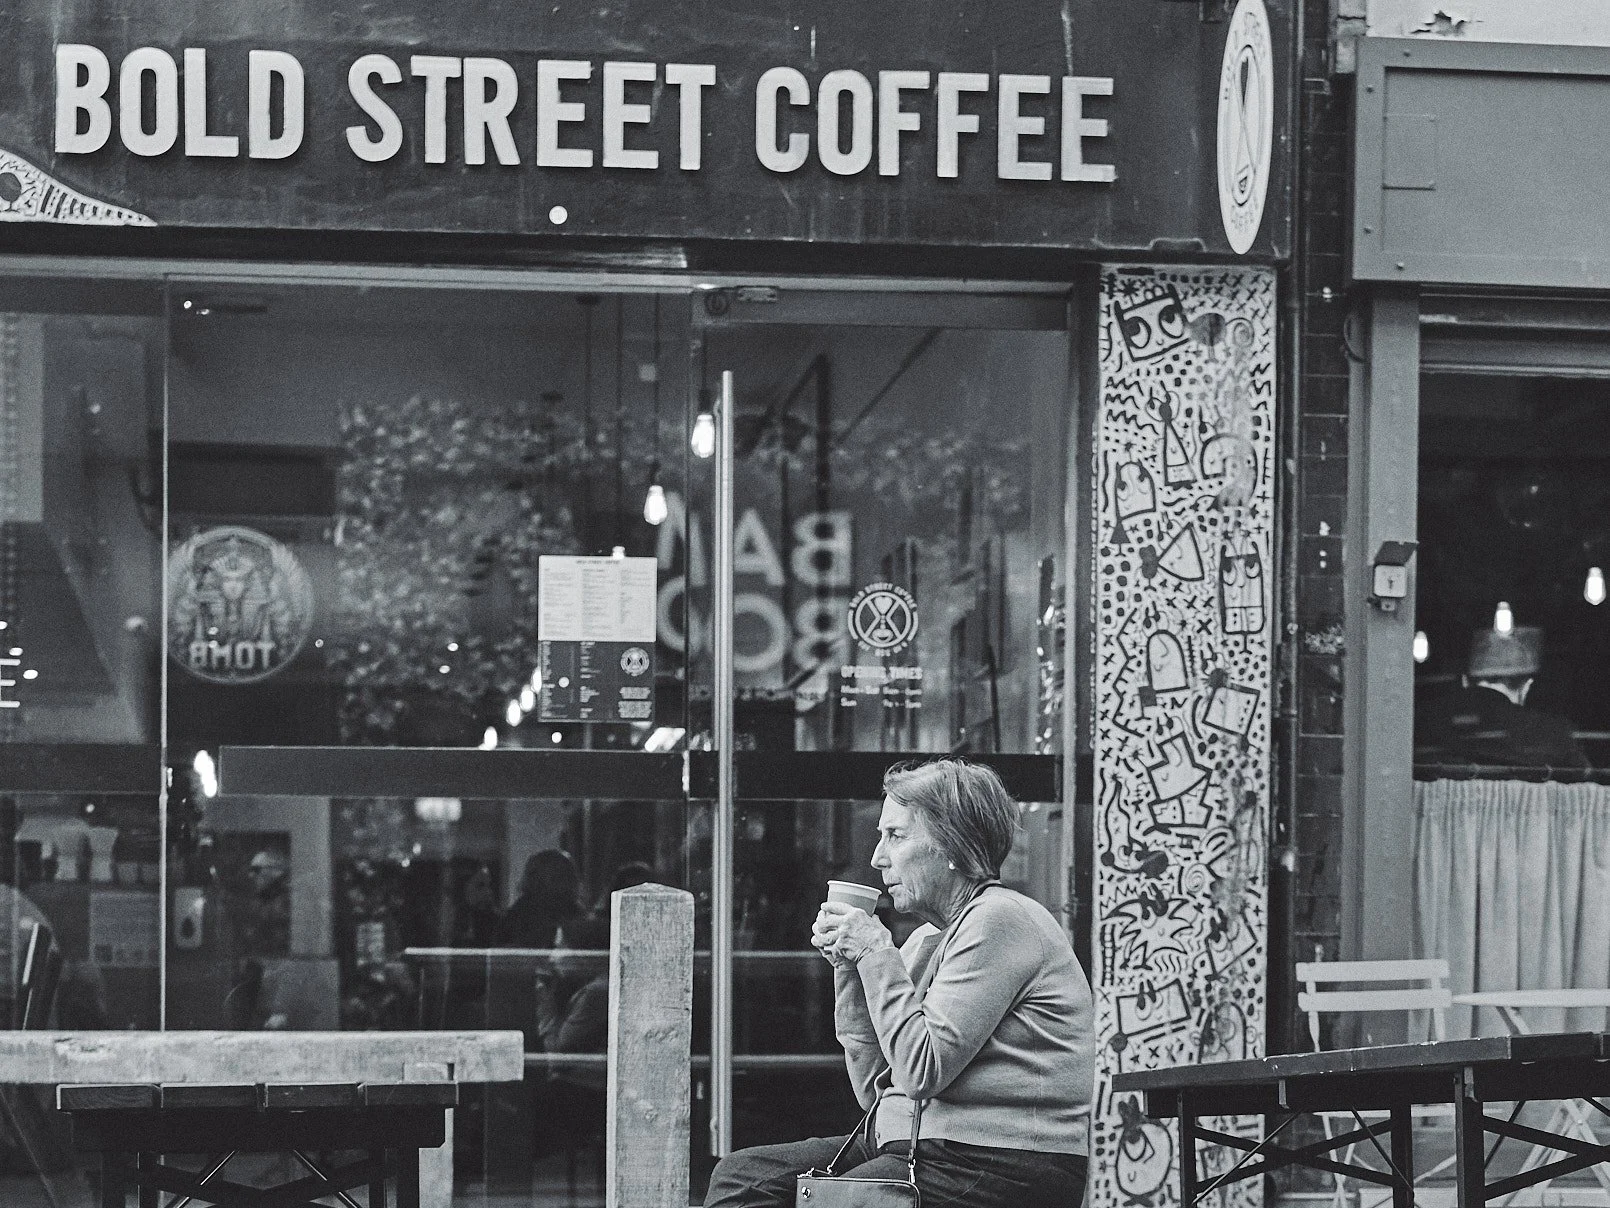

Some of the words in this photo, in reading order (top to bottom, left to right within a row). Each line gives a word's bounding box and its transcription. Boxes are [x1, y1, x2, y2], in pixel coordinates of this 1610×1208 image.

[55, 43, 304, 160] BOLD
[346, 54, 716, 171] STREET
[755, 66, 1116, 183] COFFEE
